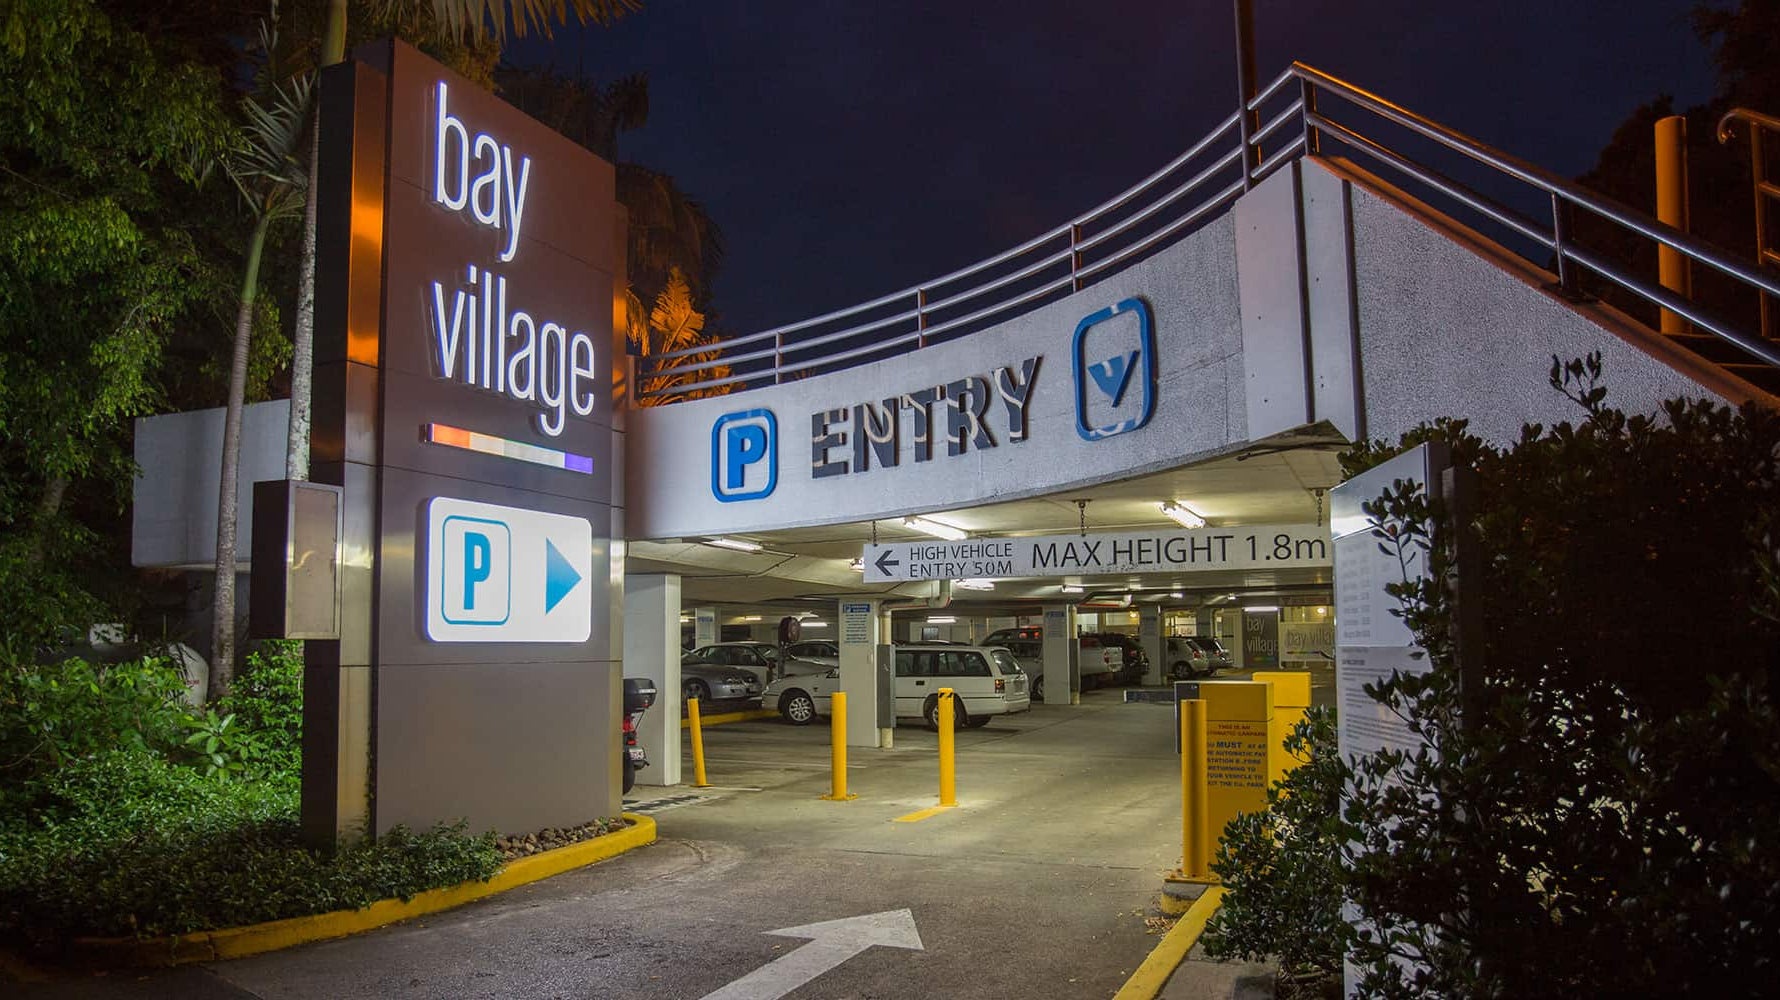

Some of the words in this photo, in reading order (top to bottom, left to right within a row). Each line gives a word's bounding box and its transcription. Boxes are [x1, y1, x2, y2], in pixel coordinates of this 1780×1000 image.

[434, 80, 531, 262] bay
[434, 264, 595, 437] village
[811, 355, 1043, 480] ENTRY
[727, 424, 768, 490] P
[463, 531, 491, 611] P
[909, 562, 967, 578] ENTRY
[973, 560, 1013, 576] 50M
[910, 546, 947, 561] HIGH
[950, 543, 1013, 559] VEHICLE
[1032, 541, 1102, 569] MAX
[1113, 535, 1235, 565] HEIGHT
[1246, 533, 1326, 561] 1.8m
[1246, 615, 1265, 635] bay
